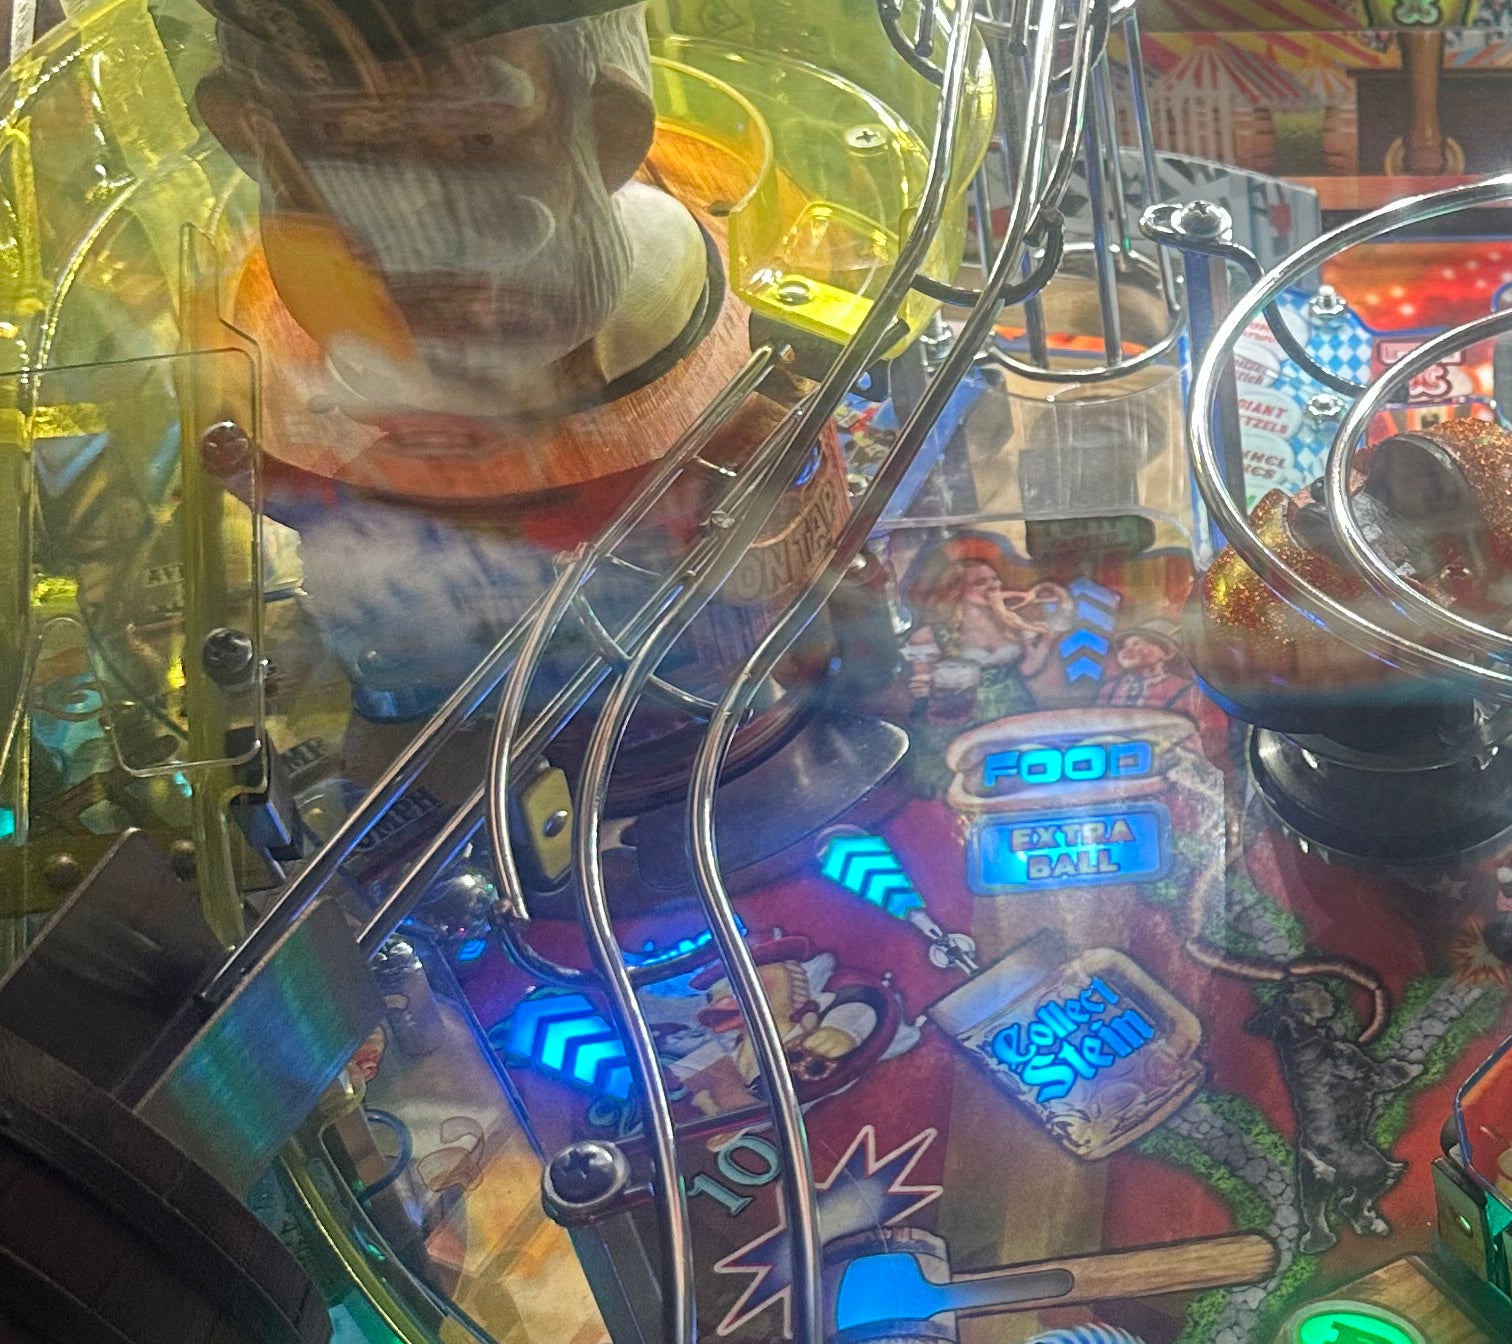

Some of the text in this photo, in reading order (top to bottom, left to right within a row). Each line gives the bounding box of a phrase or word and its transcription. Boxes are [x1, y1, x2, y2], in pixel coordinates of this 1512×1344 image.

[984, 741, 1152, 787] FOOD
[1010, 819, 1135, 852] EXTRA
[1027, 848, 1120, 880] BALL
[1021, 1009, 1154, 1103] Stein
[687, 1134, 780, 1216] 10
